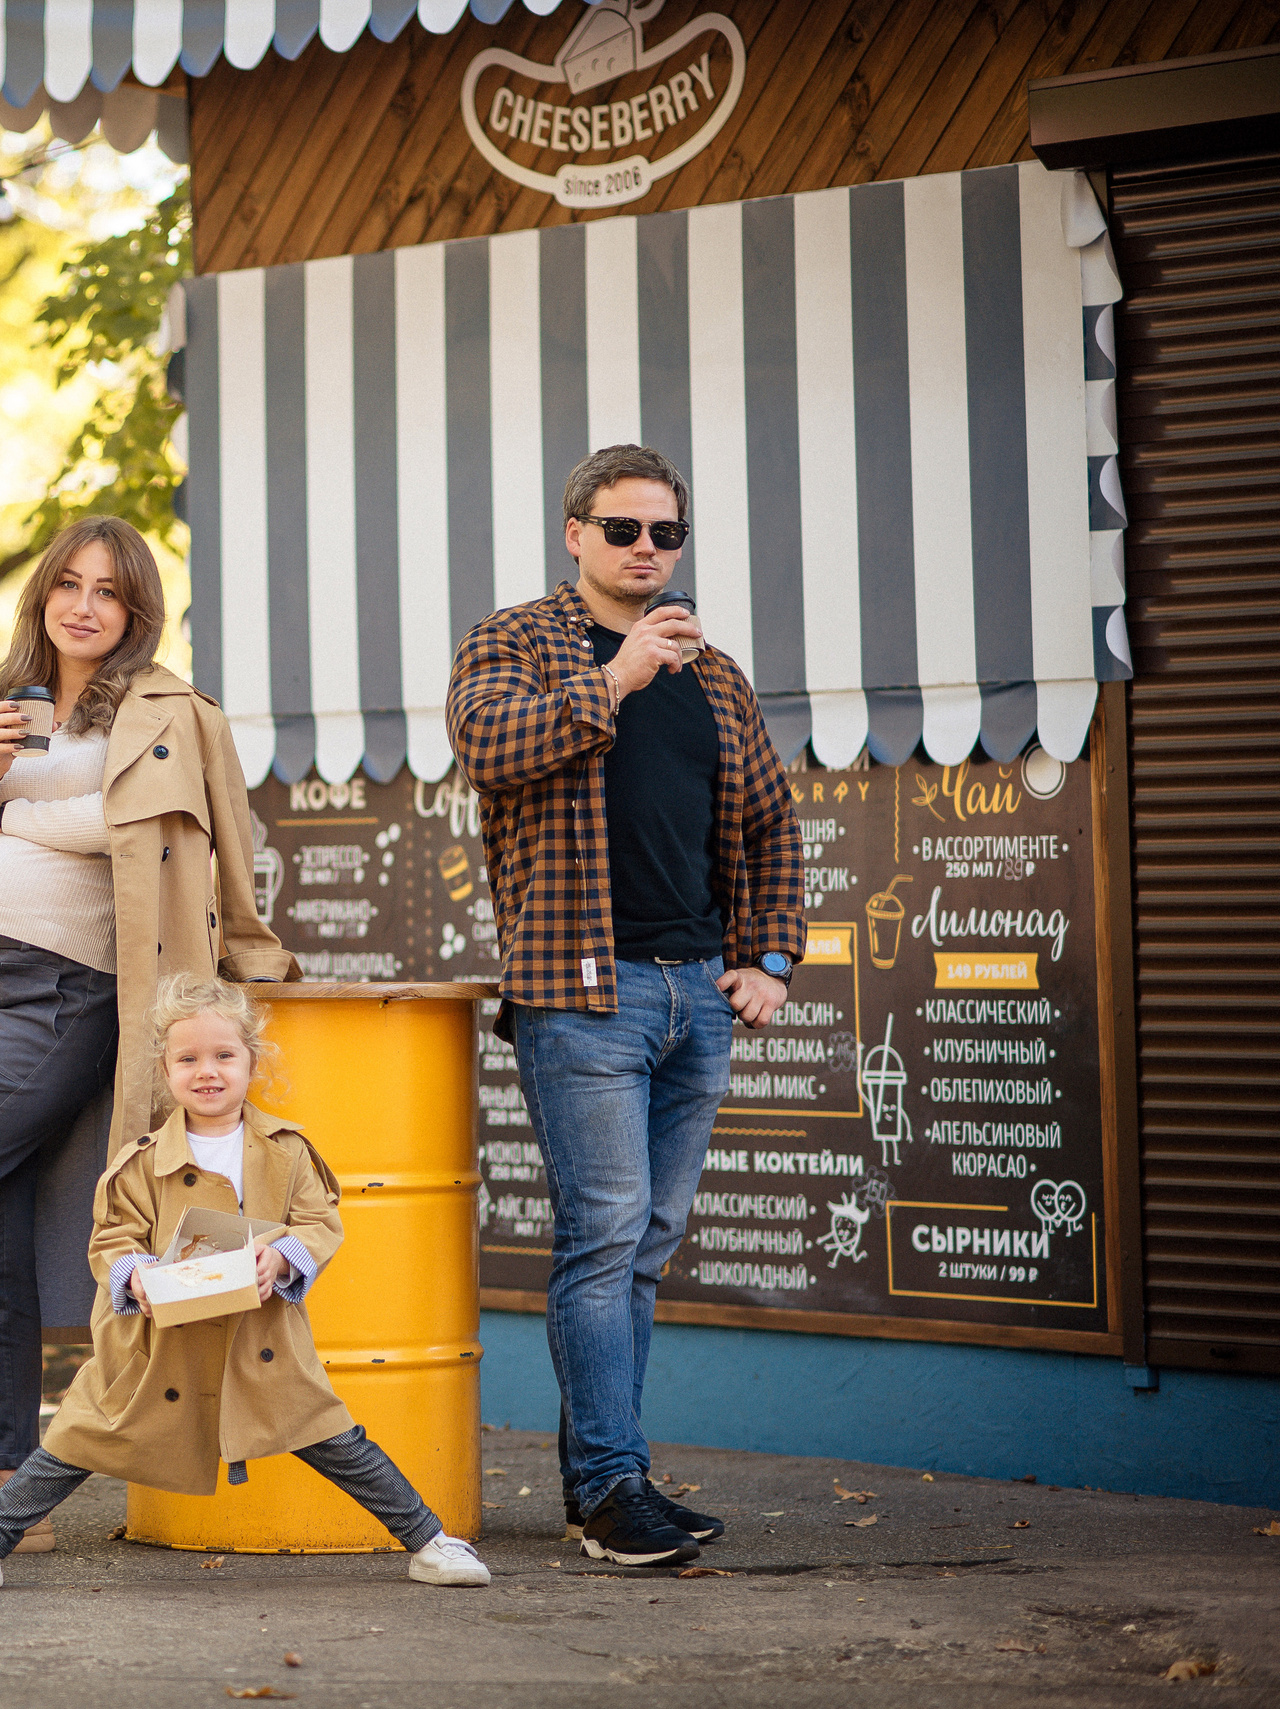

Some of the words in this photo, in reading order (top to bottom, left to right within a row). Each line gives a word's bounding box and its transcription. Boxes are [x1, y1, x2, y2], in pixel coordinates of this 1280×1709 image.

[489, 53, 715, 153] CHEESEBERRY
[563, 174, 601, 196] since
[605, 166, 643, 194] 2006
[290, 778, 367, 811] КОФЕ
[942, 757, 1022, 822] Чай
[799, 818, 836, 843] ШНЯ
[934, 834, 1059, 861] АССОРТИМЕНТЕ
[803, 866, 850, 892] ЕРСИК
[945, 861, 969, 878] 250
[972, 861, 994, 878] МЛ
[911, 885, 1070, 962] Лимонад
[807, 936, 841, 955] БЛЕЙ
[974, 960, 1028, 979] РУБЛЕЙ
[770, 1000, 834, 1026] ЕЛЬСИН
[925, 997, 1052, 1025] КЛАССИЧЕСКИЙ
[730, 1036, 765, 1062] НЫЕ
[766, 1036, 826, 1063] ОБЛАКА
[933, 1037, 1047, 1065] КЛУБНИЧНЫЙ
[773, 1073, 818, 1100] МИКС
[930, 1077, 1053, 1105] ОБЛЕПИХОВЫЙ
[930, 1120, 1063, 1149] АПЕЛЬСИНОВЫЙ
[702, 1149, 749, 1172] НЫЕ
[753, 1148, 864, 1177] КОКТЕЙЛИ
[952, 1152, 1028, 1179] КЮРАСАО
[692, 1191, 808, 1221] КЛАССИЧЕСКИЙ
[699, 1226, 805, 1256] КЛУБНИЧНЫЙ
[911, 1223, 1051, 1260] СЫРНИКИ
[699, 1260, 808, 1291] ШОКОЛАДНЫЙ
[938, 1261, 948, 1279] 2
[949, 1262, 997, 1281] ШТУКИ
[1008, 1266, 1026, 1283] 99
